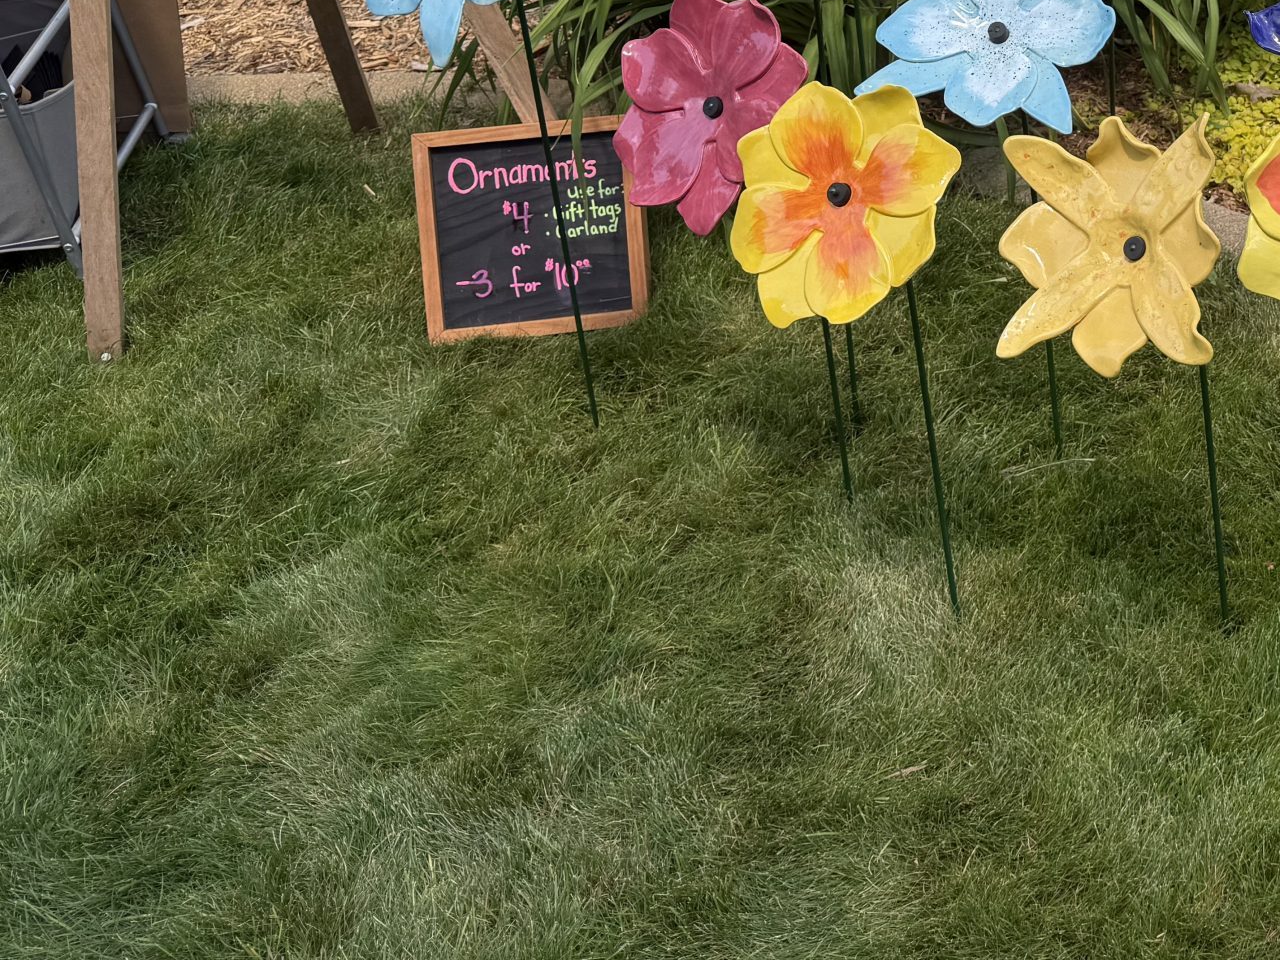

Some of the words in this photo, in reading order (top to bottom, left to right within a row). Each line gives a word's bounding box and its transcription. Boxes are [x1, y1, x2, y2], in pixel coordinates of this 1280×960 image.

[589, 199, 622, 223] tags
[511, 243, 531, 256] or
[509, 265, 541, 298] for
